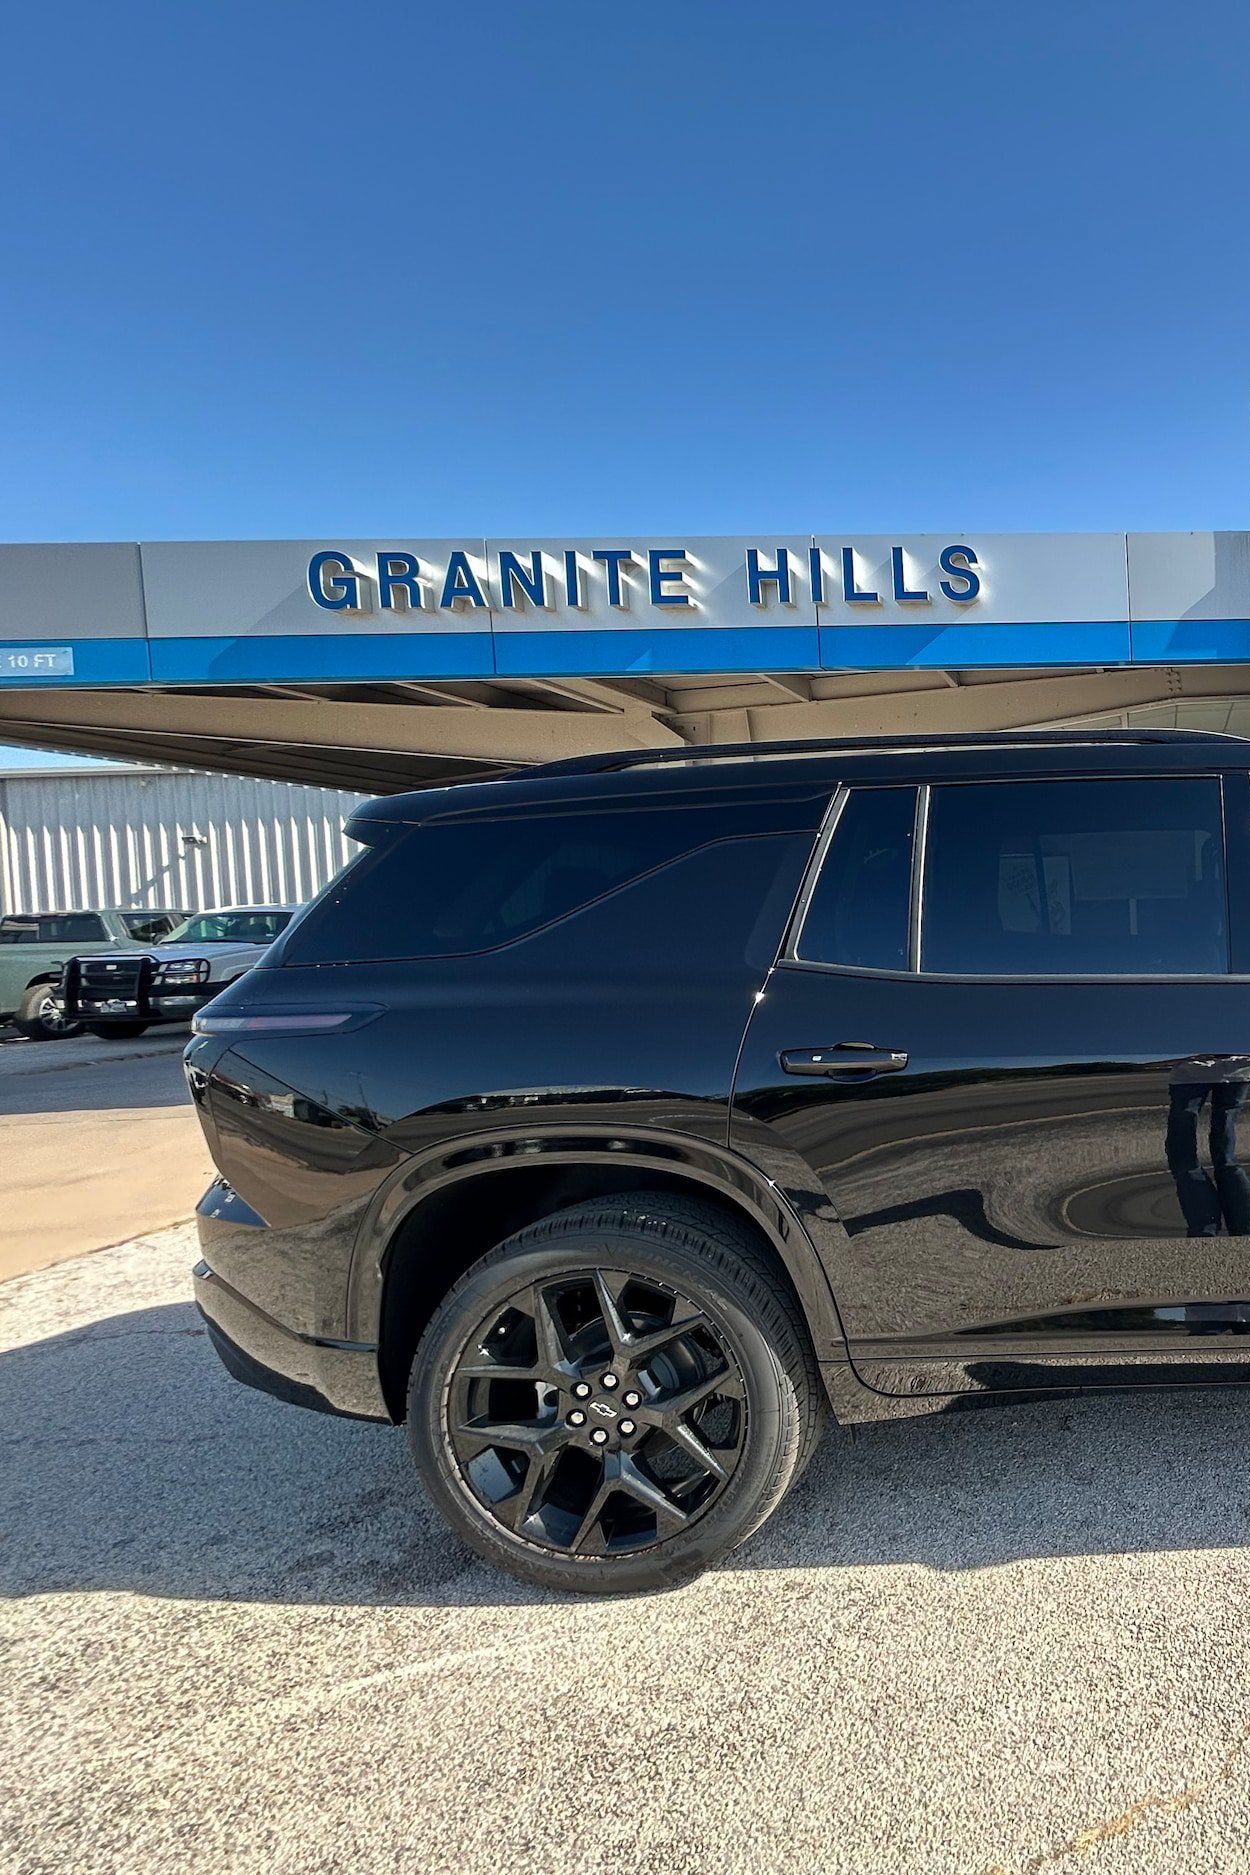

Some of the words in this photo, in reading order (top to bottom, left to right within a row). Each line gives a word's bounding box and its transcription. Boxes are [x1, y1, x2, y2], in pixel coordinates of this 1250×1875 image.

[307, 549, 698, 613] GRANITE
[746, 544, 982, 605] HILLS
[8, 654, 28, 668] 10
[33, 653, 56, 668] FT
